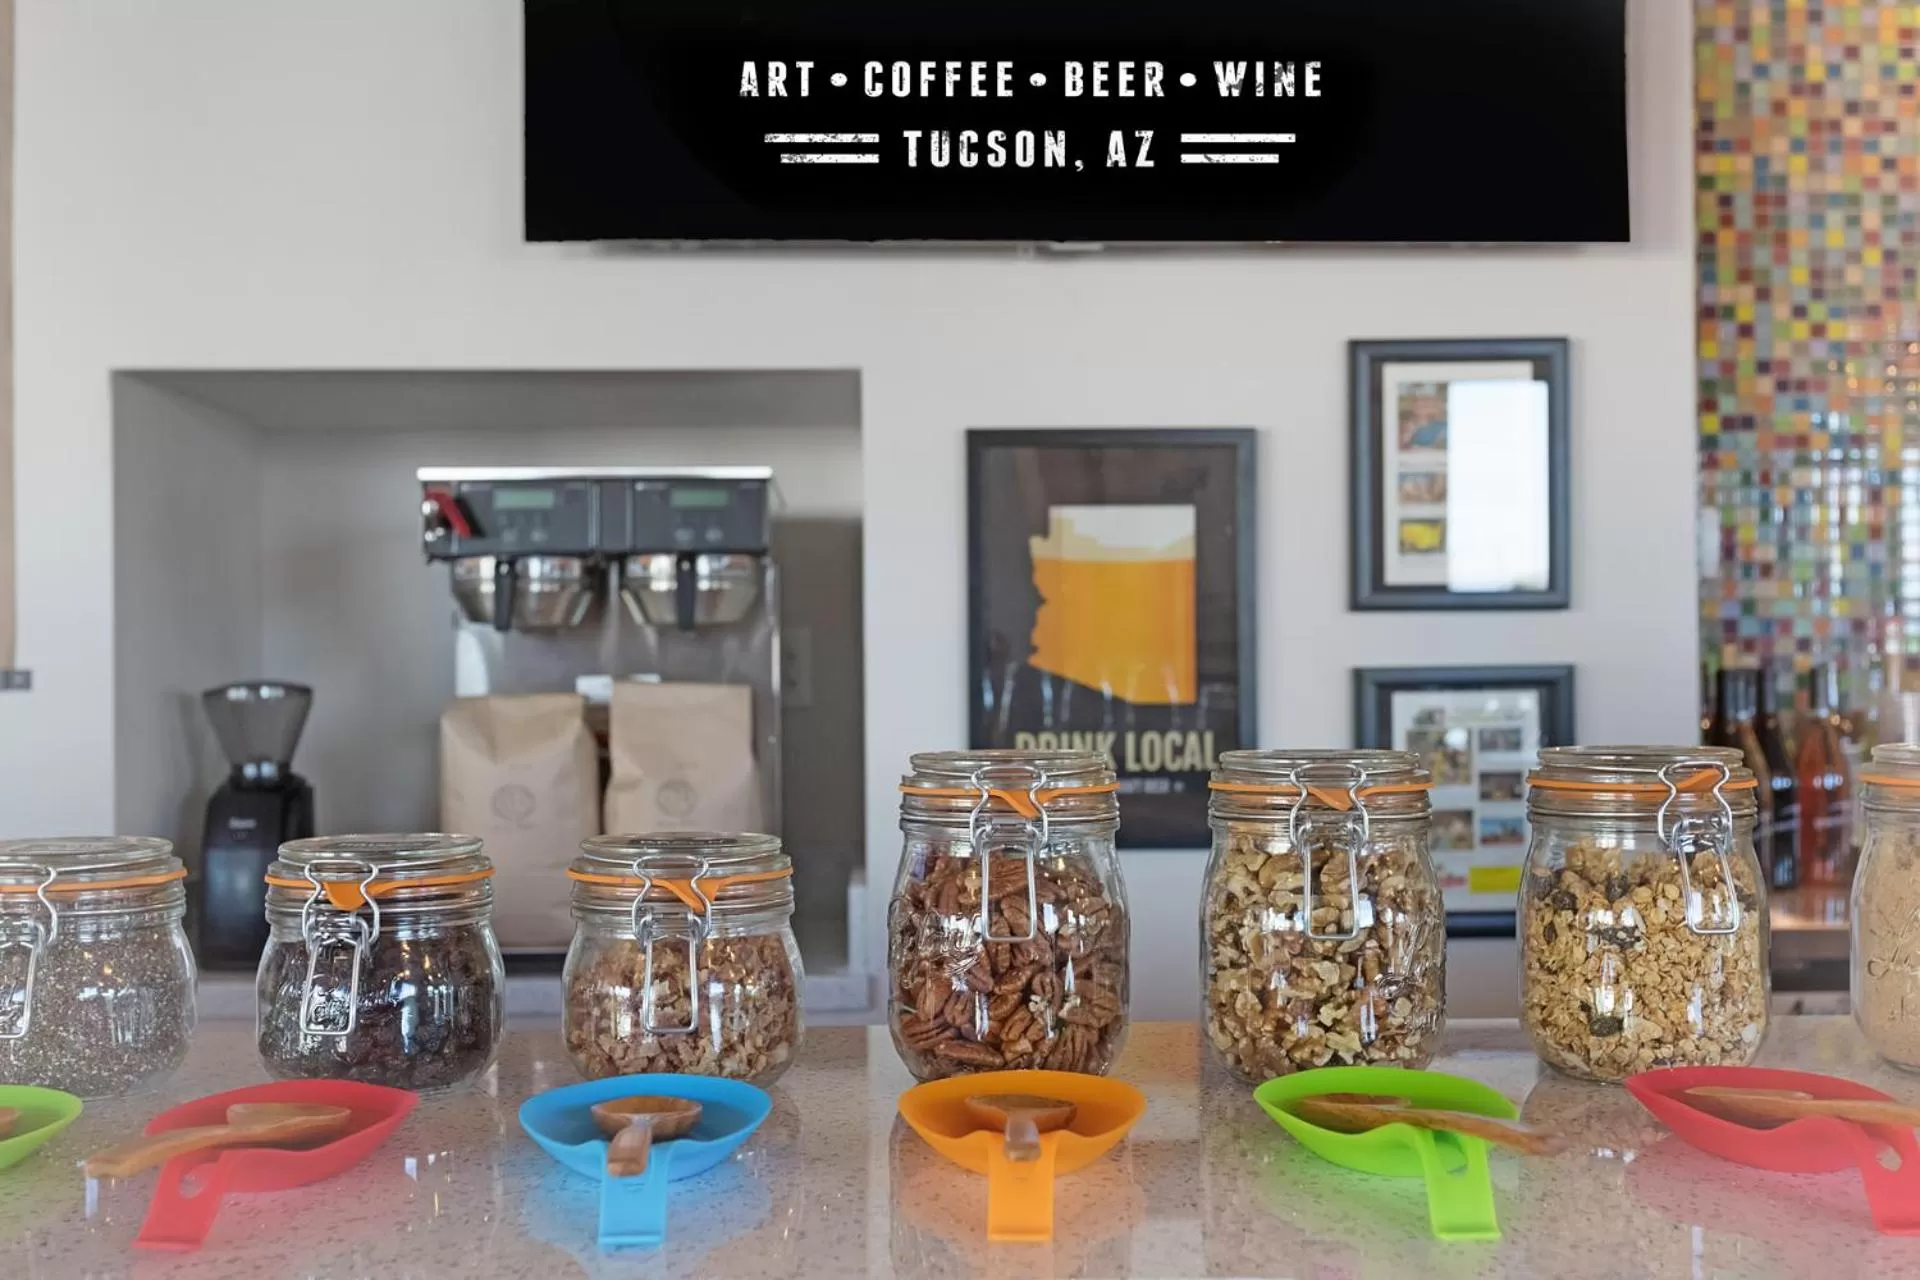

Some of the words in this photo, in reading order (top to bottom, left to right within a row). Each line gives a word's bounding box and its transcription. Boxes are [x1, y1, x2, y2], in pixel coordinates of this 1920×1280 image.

[740, 61, 814, 97] ART
[865, 61, 1014, 97] COFFEE
[1065, 61, 1165, 97] BEER
[1214, 61, 1322, 97] WINE
[903, 130, 1084, 172] TUCSON,
[1107, 130, 1155, 167] AZ
[1125, 730, 1219, 771] LOCAL
